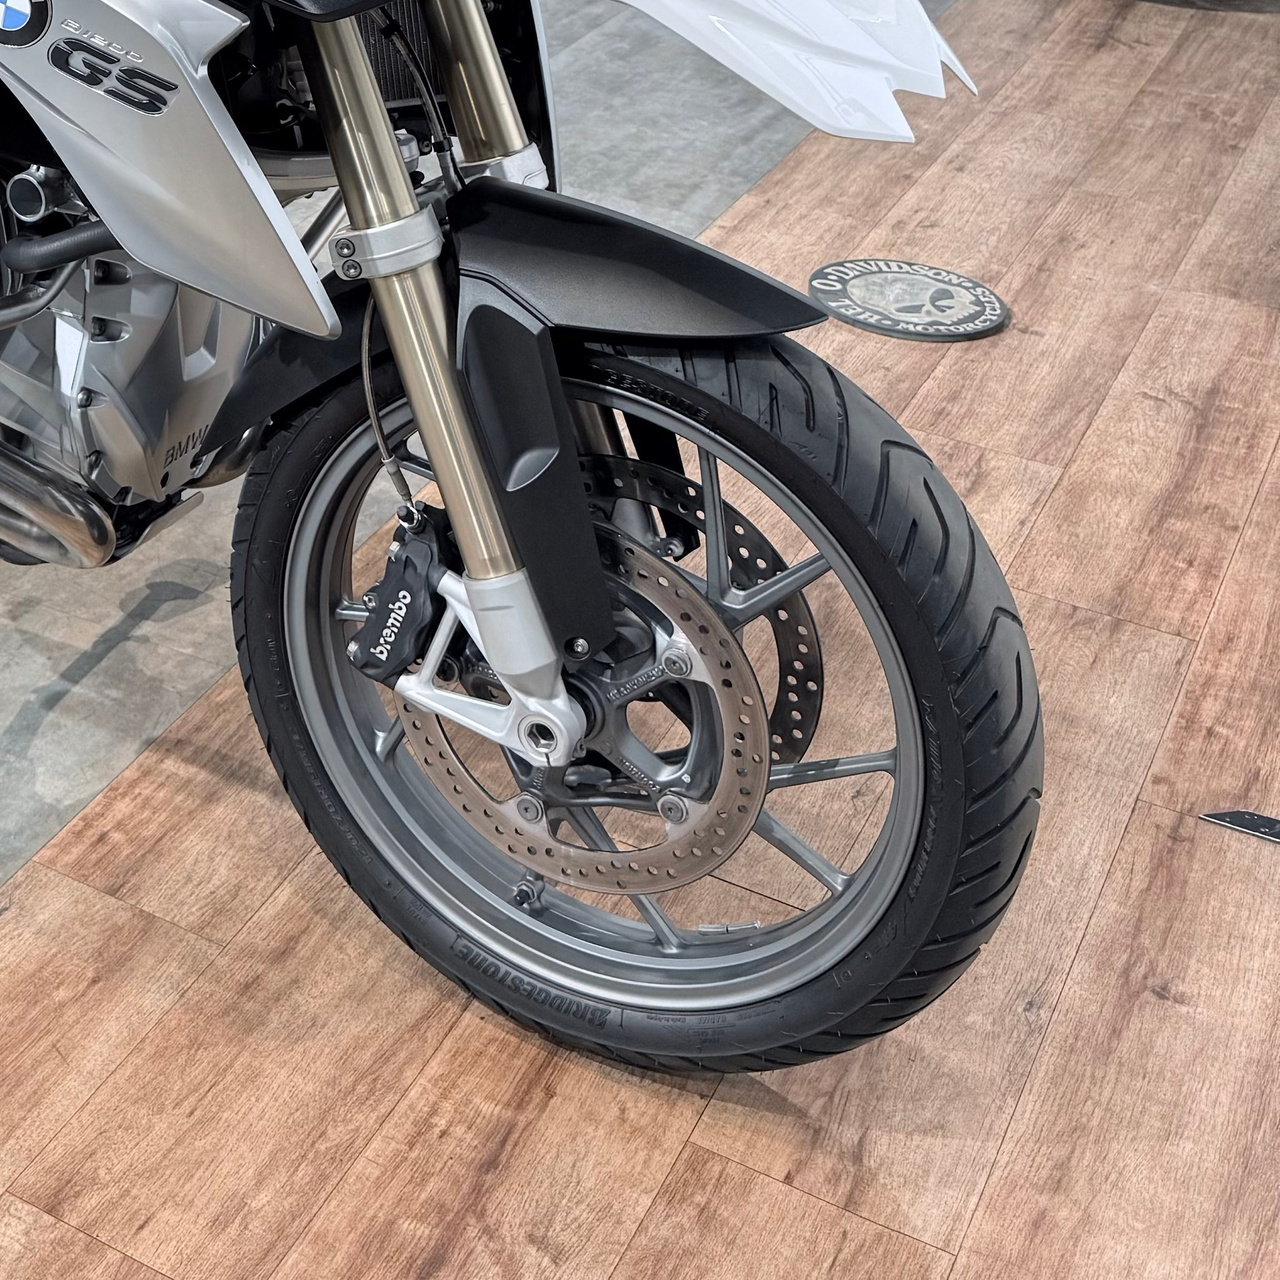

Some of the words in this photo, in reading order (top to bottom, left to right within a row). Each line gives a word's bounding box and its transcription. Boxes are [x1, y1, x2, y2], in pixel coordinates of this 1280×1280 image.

[60, 18, 145, 63] R1200
[47, 36, 180, 116] GS
[823, 260, 966, 285] DAVIDSON
[811, 278, 884, 324] HELO
[896, 287, 1001, 334] MOTORCYCLES
[163, 424, 210, 469] BMW
[370, 590, 412, 662] brembo
[453, 941, 612, 1030] BRIDGESTONE
